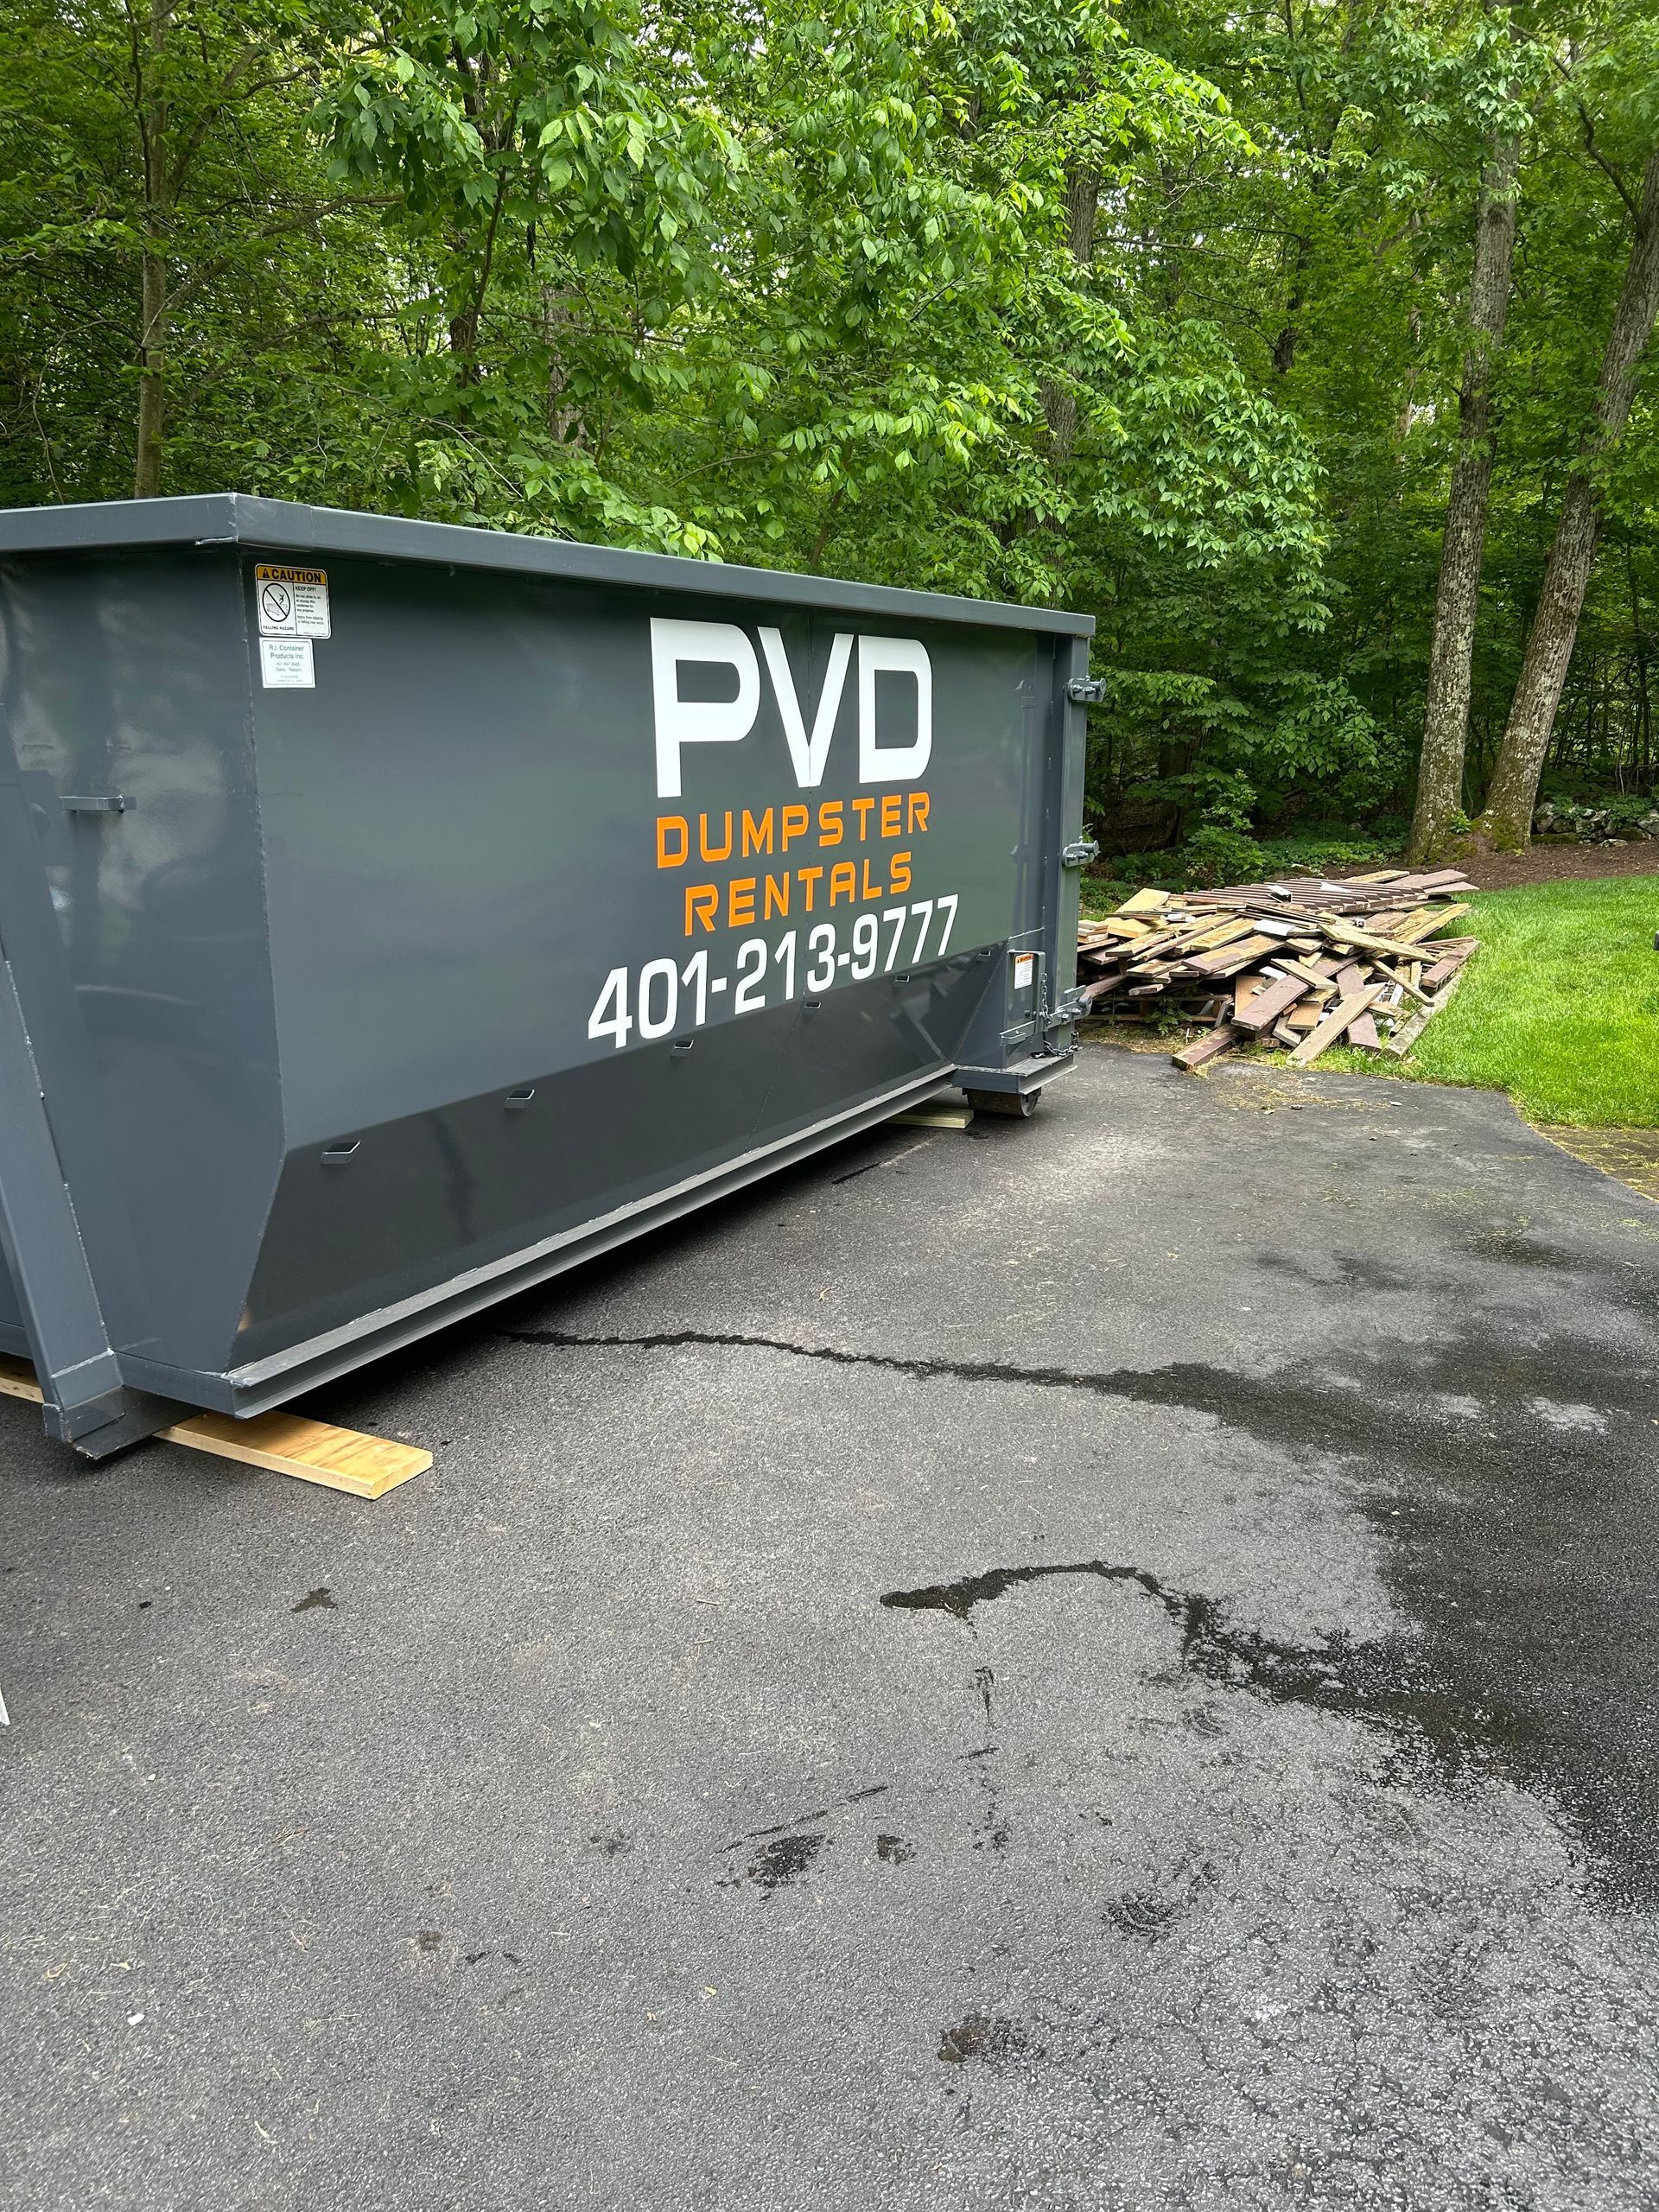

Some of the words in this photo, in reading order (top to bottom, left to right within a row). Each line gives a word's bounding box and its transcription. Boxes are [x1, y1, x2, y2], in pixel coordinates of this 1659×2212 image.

[271, 569, 321, 583] CAUTION
[650, 617, 932, 798] PVD
[656, 791, 930, 868] DUMPSTER
[685, 852, 911, 936] RENTALS
[588, 894, 959, 1049] 401-213-9777
